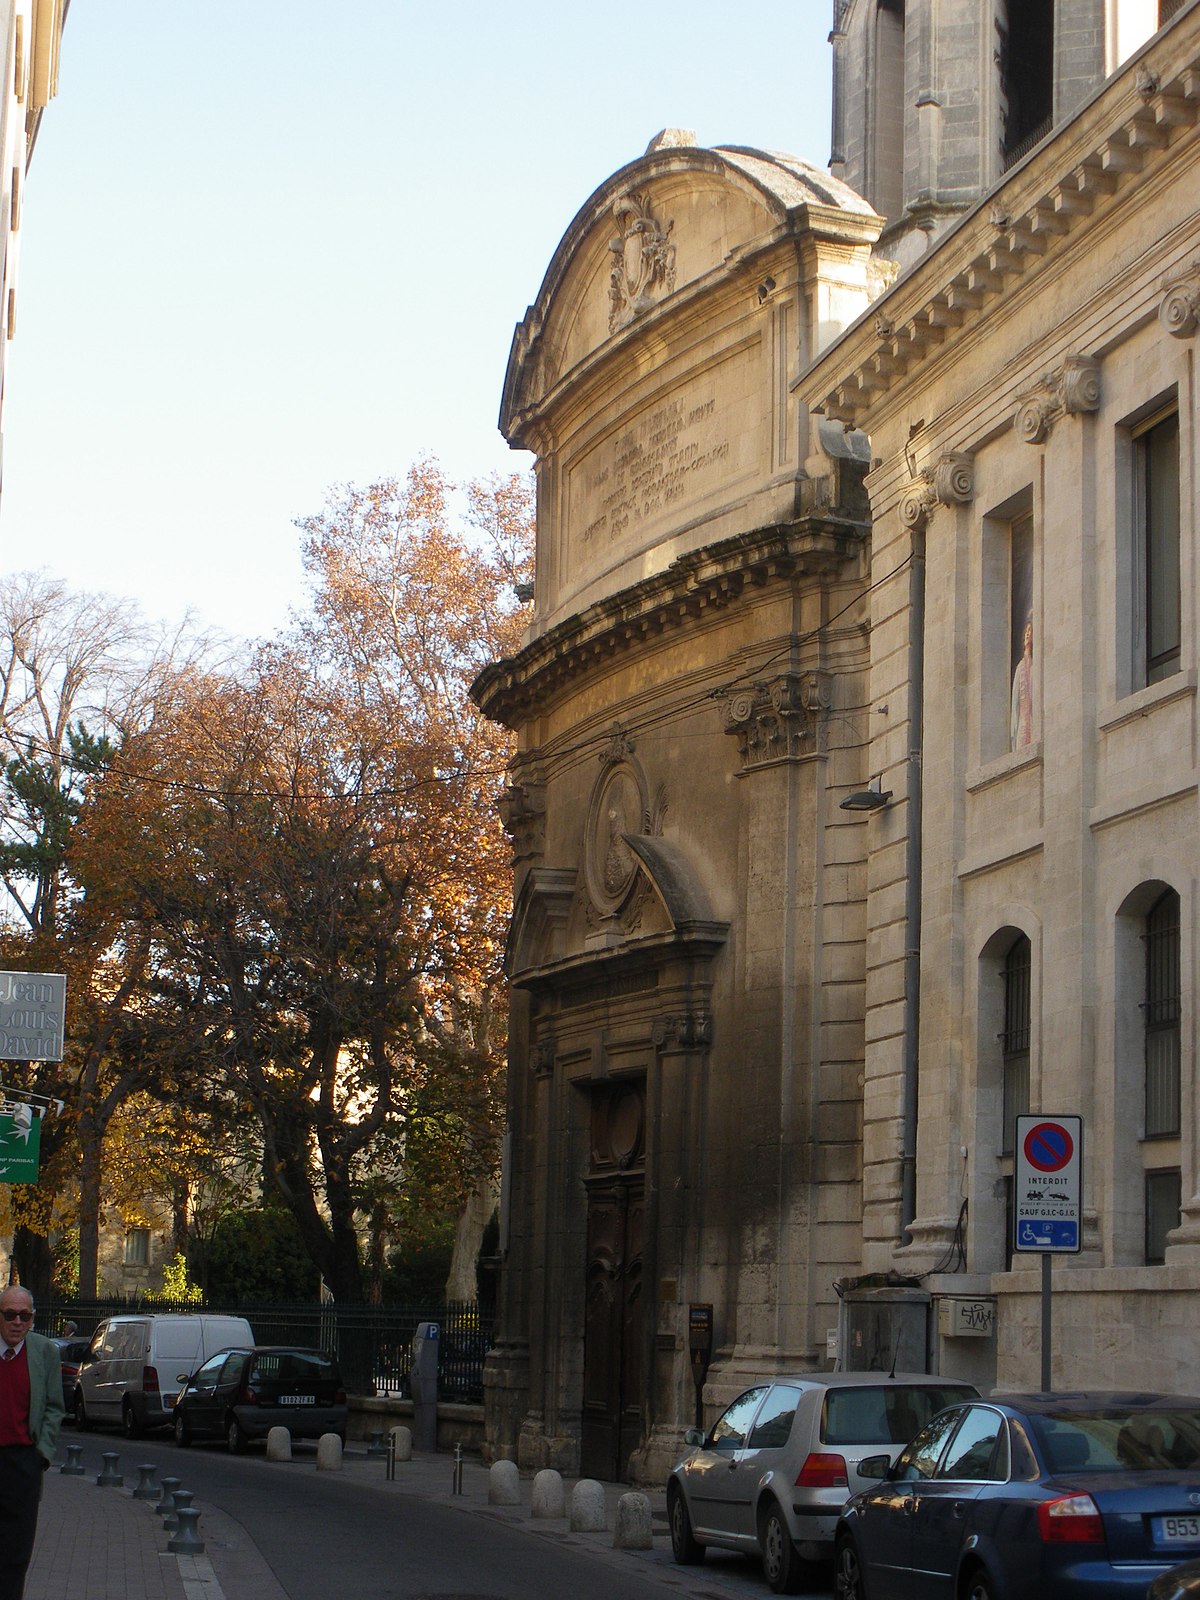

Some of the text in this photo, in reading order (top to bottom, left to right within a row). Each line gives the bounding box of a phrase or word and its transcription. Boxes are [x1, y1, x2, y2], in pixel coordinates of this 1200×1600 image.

[0, 975, 54, 1003] Jean
[1028, 1177, 1069, 1185] INTERDIT
[1019, 1208, 1040, 1216] SAUF
[429, 1326, 438, 1338] P
[1166, 1519, 1199, 1536] 953
